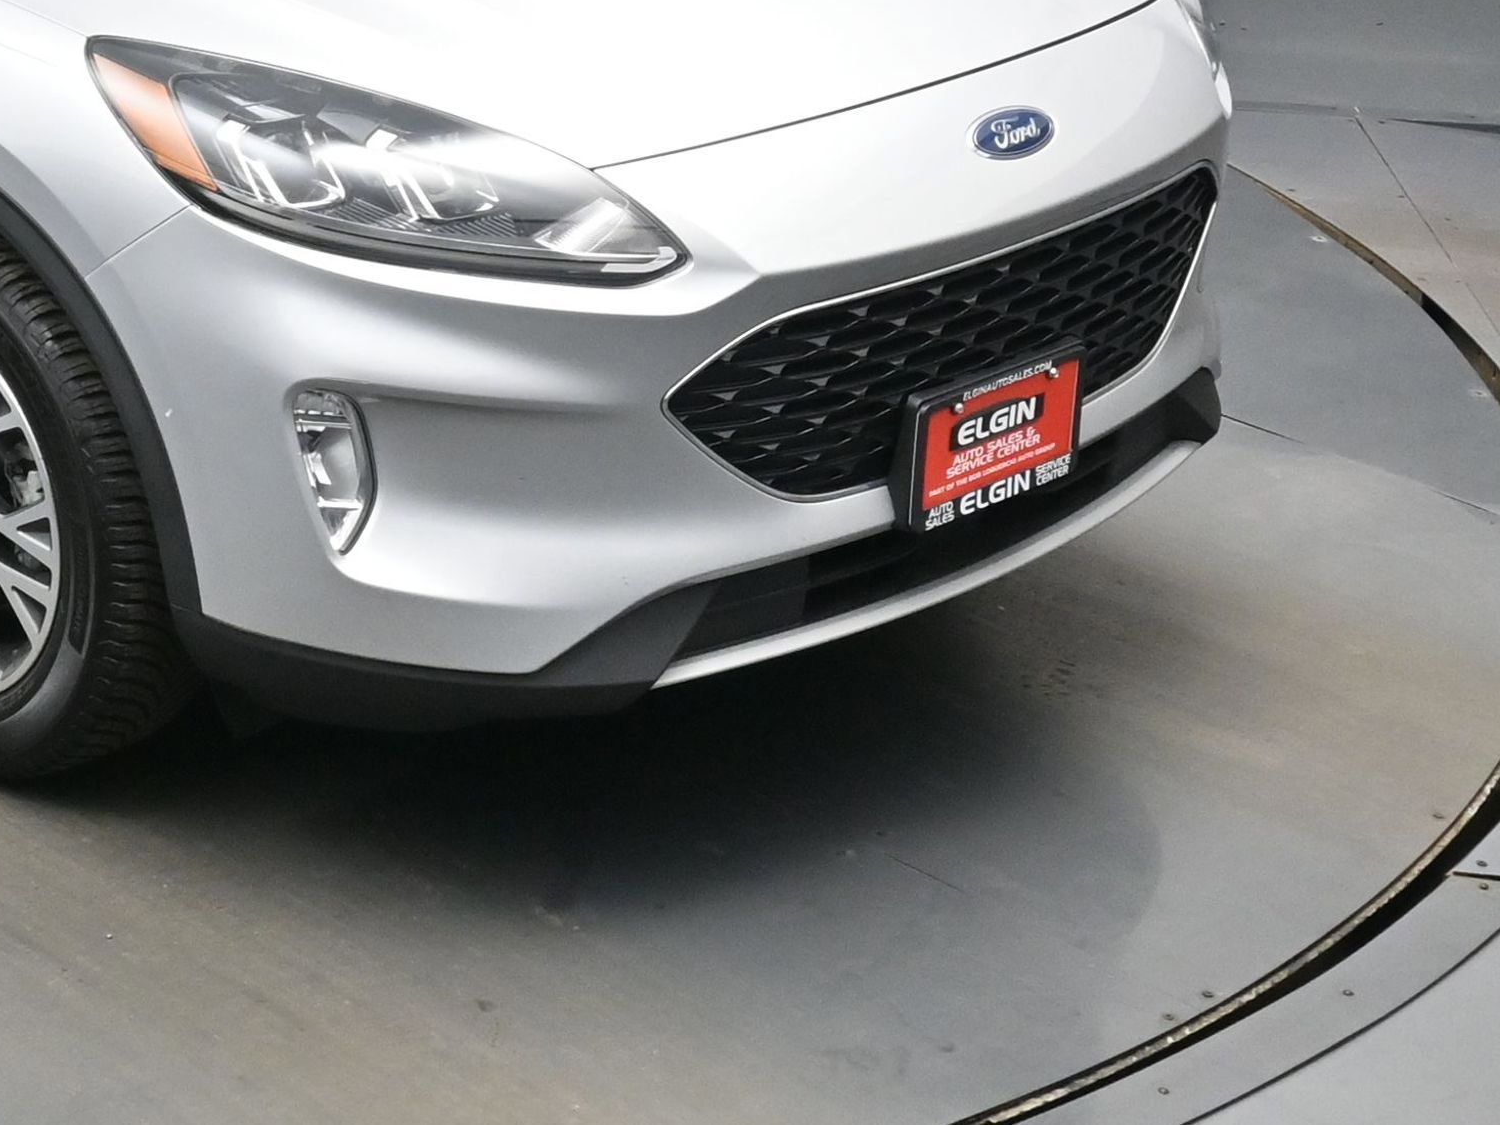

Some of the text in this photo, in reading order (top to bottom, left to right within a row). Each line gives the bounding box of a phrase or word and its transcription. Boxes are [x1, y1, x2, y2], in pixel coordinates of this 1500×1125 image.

[990, 116, 1038, 149] Ford
[962, 359, 1053, 402] ELGINAUTOSALES.COM
[957, 396, 1037, 446] ELGIN
[945, 451, 995, 480] SERVICE
[996, 433, 1041, 459] CENTER
[952, 445, 985, 467] AUTO
[986, 430, 1024, 453] SALES
[1026, 426, 1037, 438] &
[1035, 453, 1071, 476] SERVICE
[959, 469, 1031, 516] ELGIN
[1036, 465, 1069, 486] CENTER
[924, 510, 955, 532] SALES
[928, 501, 954, 519] AUTO
